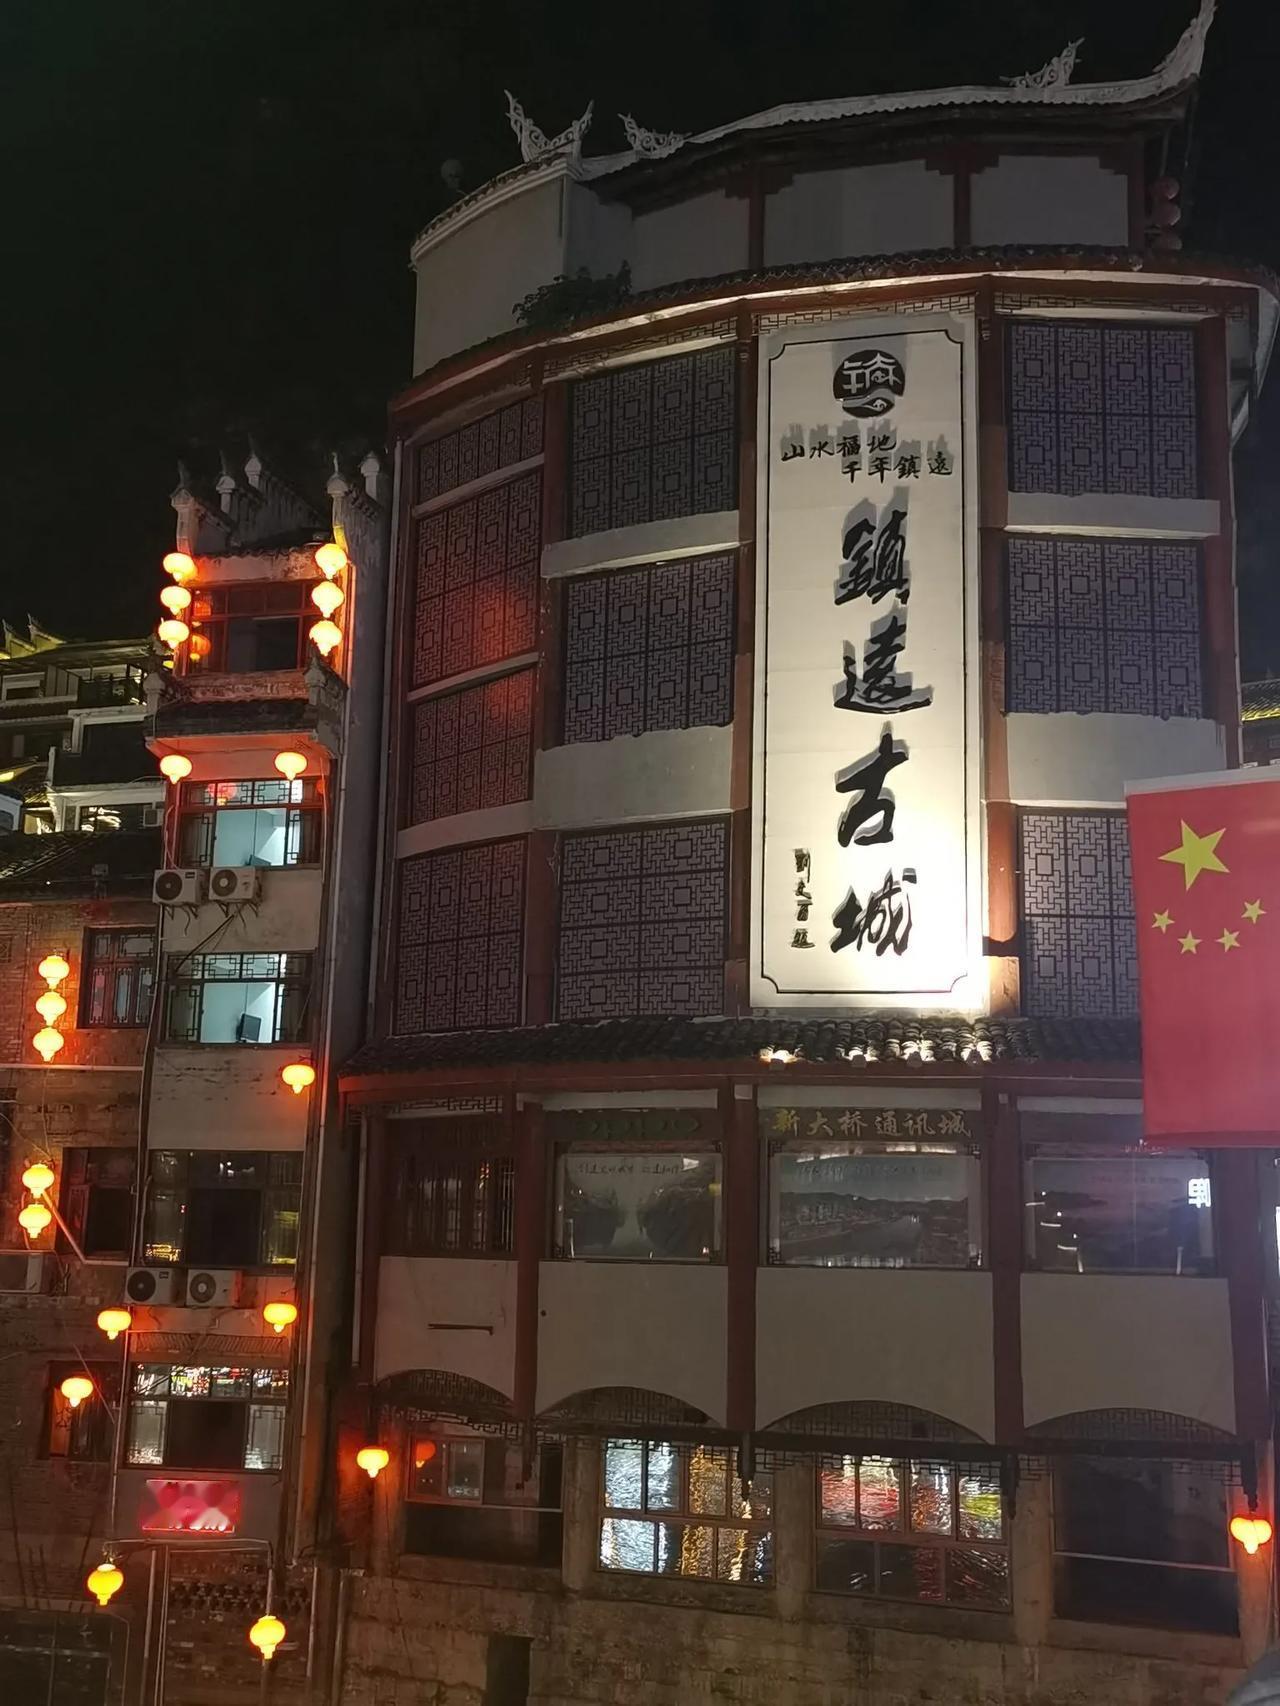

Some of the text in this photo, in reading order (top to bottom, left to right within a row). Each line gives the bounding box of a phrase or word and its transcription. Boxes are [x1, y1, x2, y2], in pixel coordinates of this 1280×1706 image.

[781, 434, 897, 461] 山水福地
[772, 1109, 972, 1137] 新大桥通讯城
